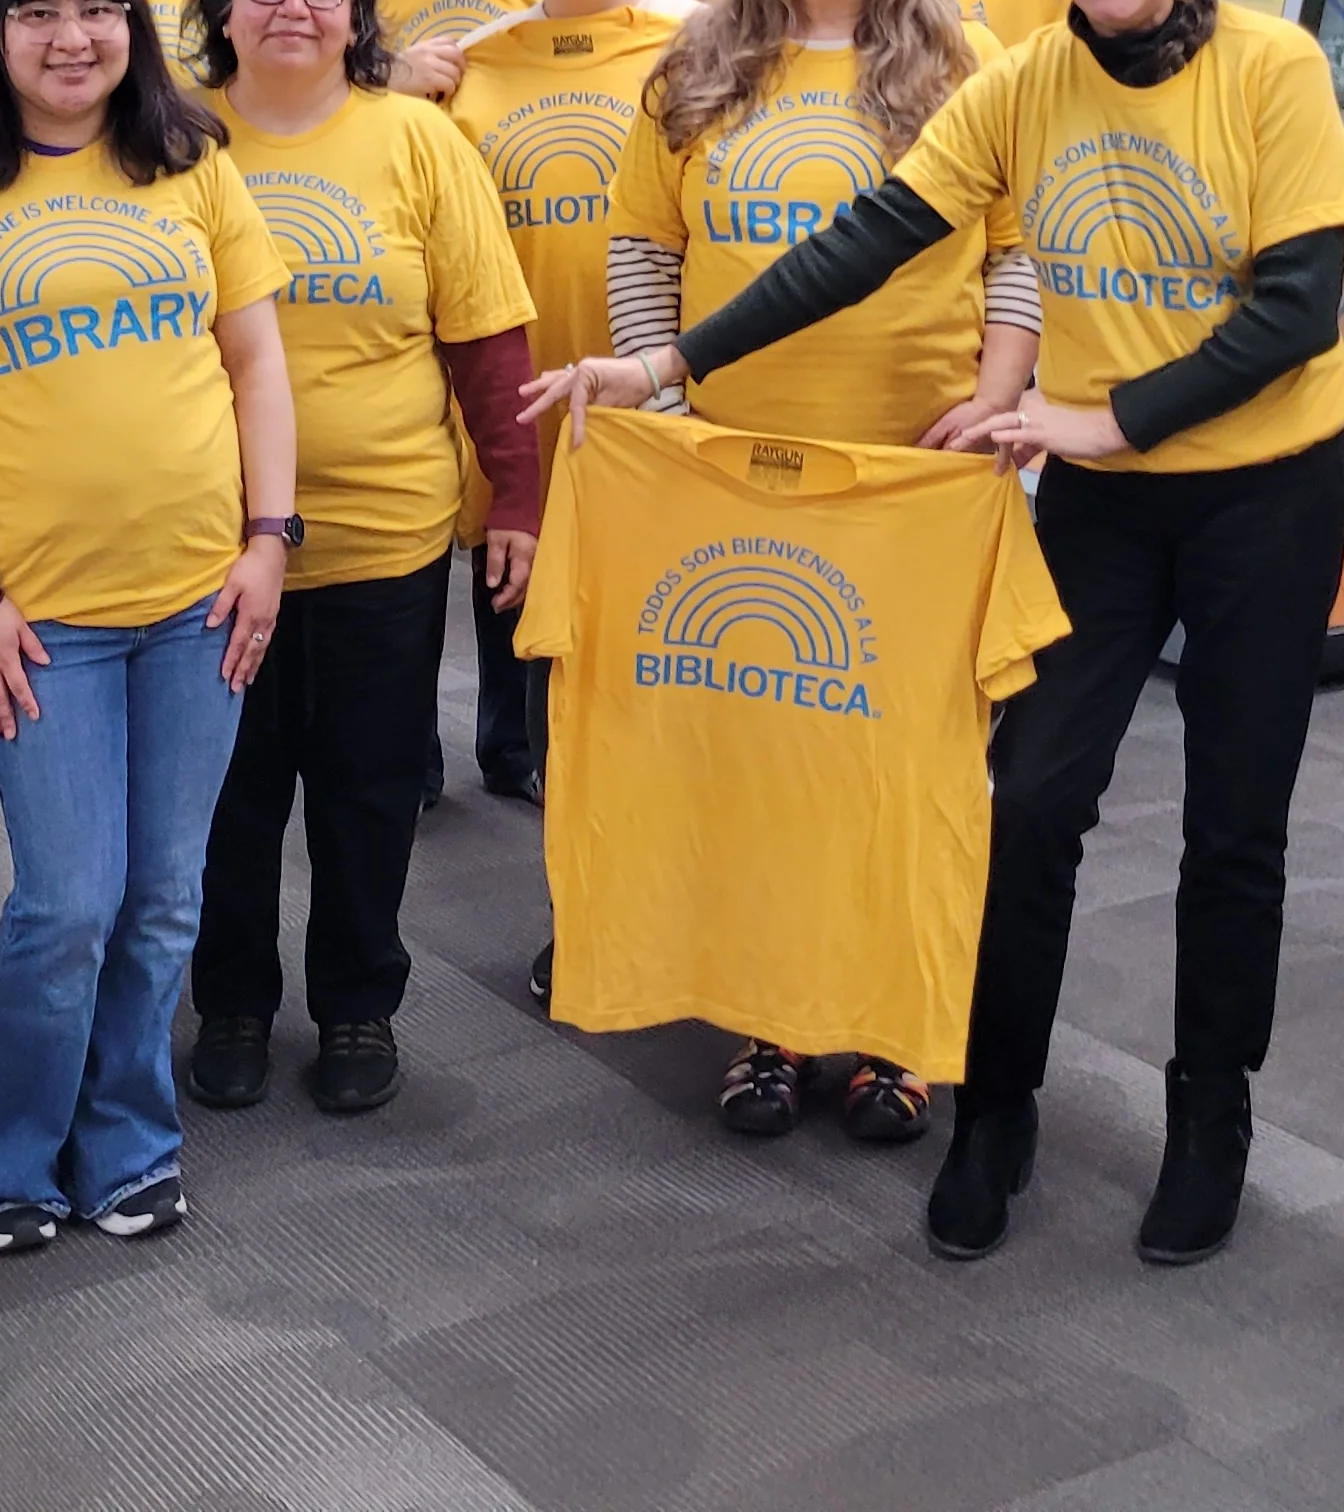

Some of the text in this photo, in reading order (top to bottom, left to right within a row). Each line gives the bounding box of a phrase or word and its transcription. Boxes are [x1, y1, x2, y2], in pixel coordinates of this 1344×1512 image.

[498, 91, 635, 132] SON BIENVENID
[776, 98, 795, 113] IS
[801, 91, 860, 109] WELC
[1054, 138, 1097, 175] SON
[245, 171, 386, 258] BIENVENIDOS A LA
[505, 195, 610, 228] BLIOT
[703, 200, 854, 245] LIBR
[1210, 214, 1228, 230] A
[21, 202, 42, 220] IS
[45, 194, 152, 224] WELCOME
[154, 217, 182, 236] AT
[182, 238, 209, 278] THE
[1218, 231, 1244, 261] LA
[751, 443, 804, 465] RAYGUN
[638, 537, 878, 665] TODOS SON BIENVENIDOS A LA
[635, 653, 869, 718] BIBLIOTECA
